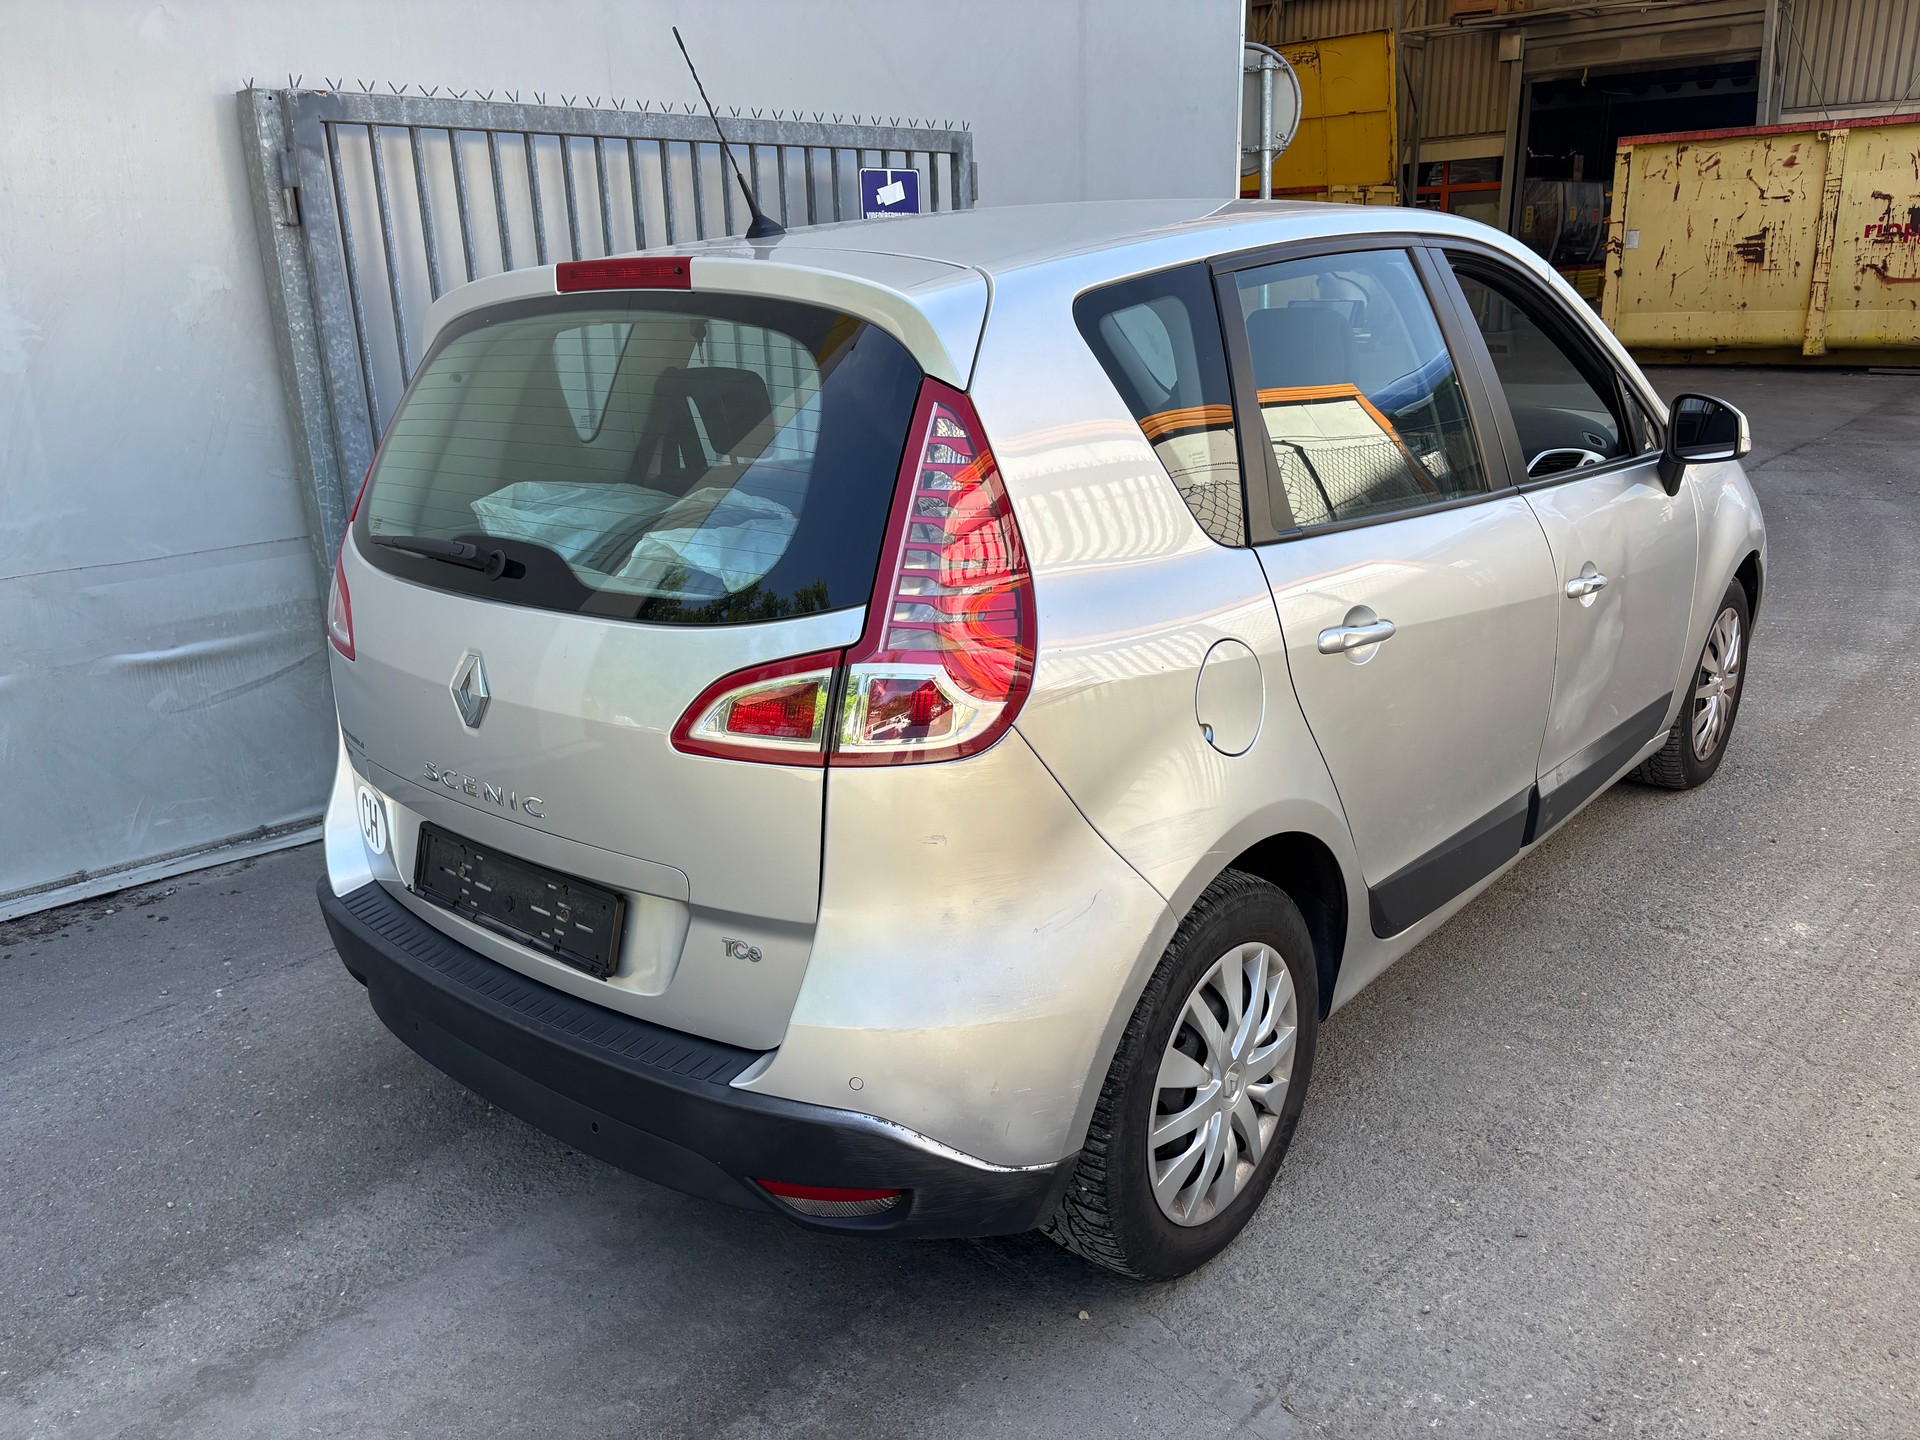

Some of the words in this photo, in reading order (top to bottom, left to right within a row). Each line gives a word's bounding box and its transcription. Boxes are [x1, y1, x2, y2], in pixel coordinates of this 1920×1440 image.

[423, 760, 546, 818] SCENIC
[361, 791, 380, 849] CH
[721, 936, 763, 963] TCe
